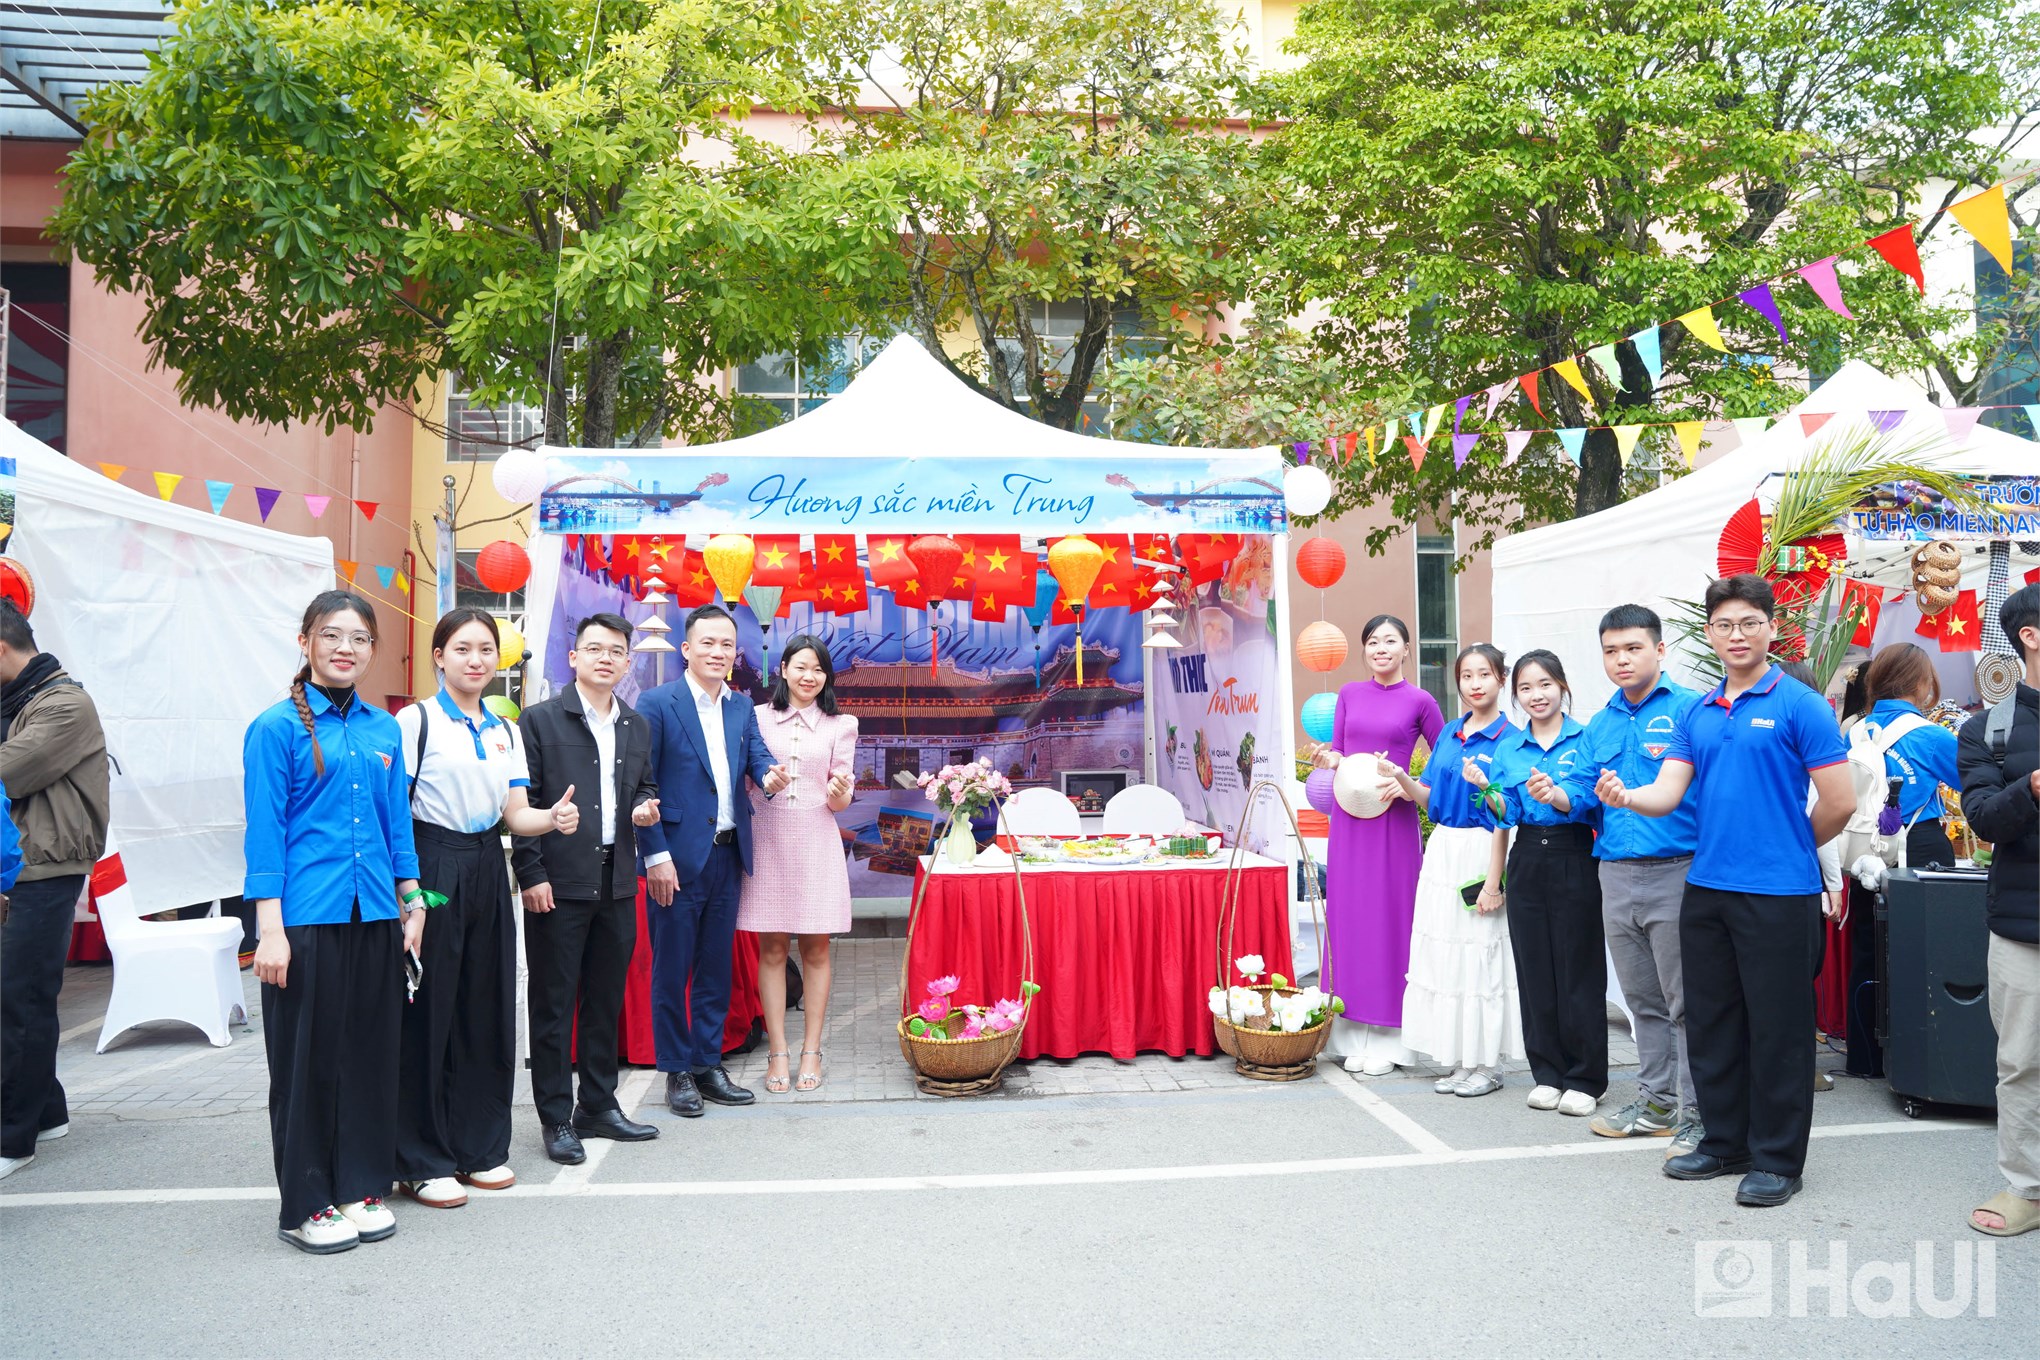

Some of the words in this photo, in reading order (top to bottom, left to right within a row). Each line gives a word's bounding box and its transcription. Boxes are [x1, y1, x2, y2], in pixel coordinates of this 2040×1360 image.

[748, 473, 863, 524] Hương
[868, 482, 917, 514] sắc
[926, 482, 995, 513] miền
[1003, 473, 1094, 524] Trung
[1853, 510, 1882, 538] TỰ
[1886, 508, 1936, 532] HÀO
